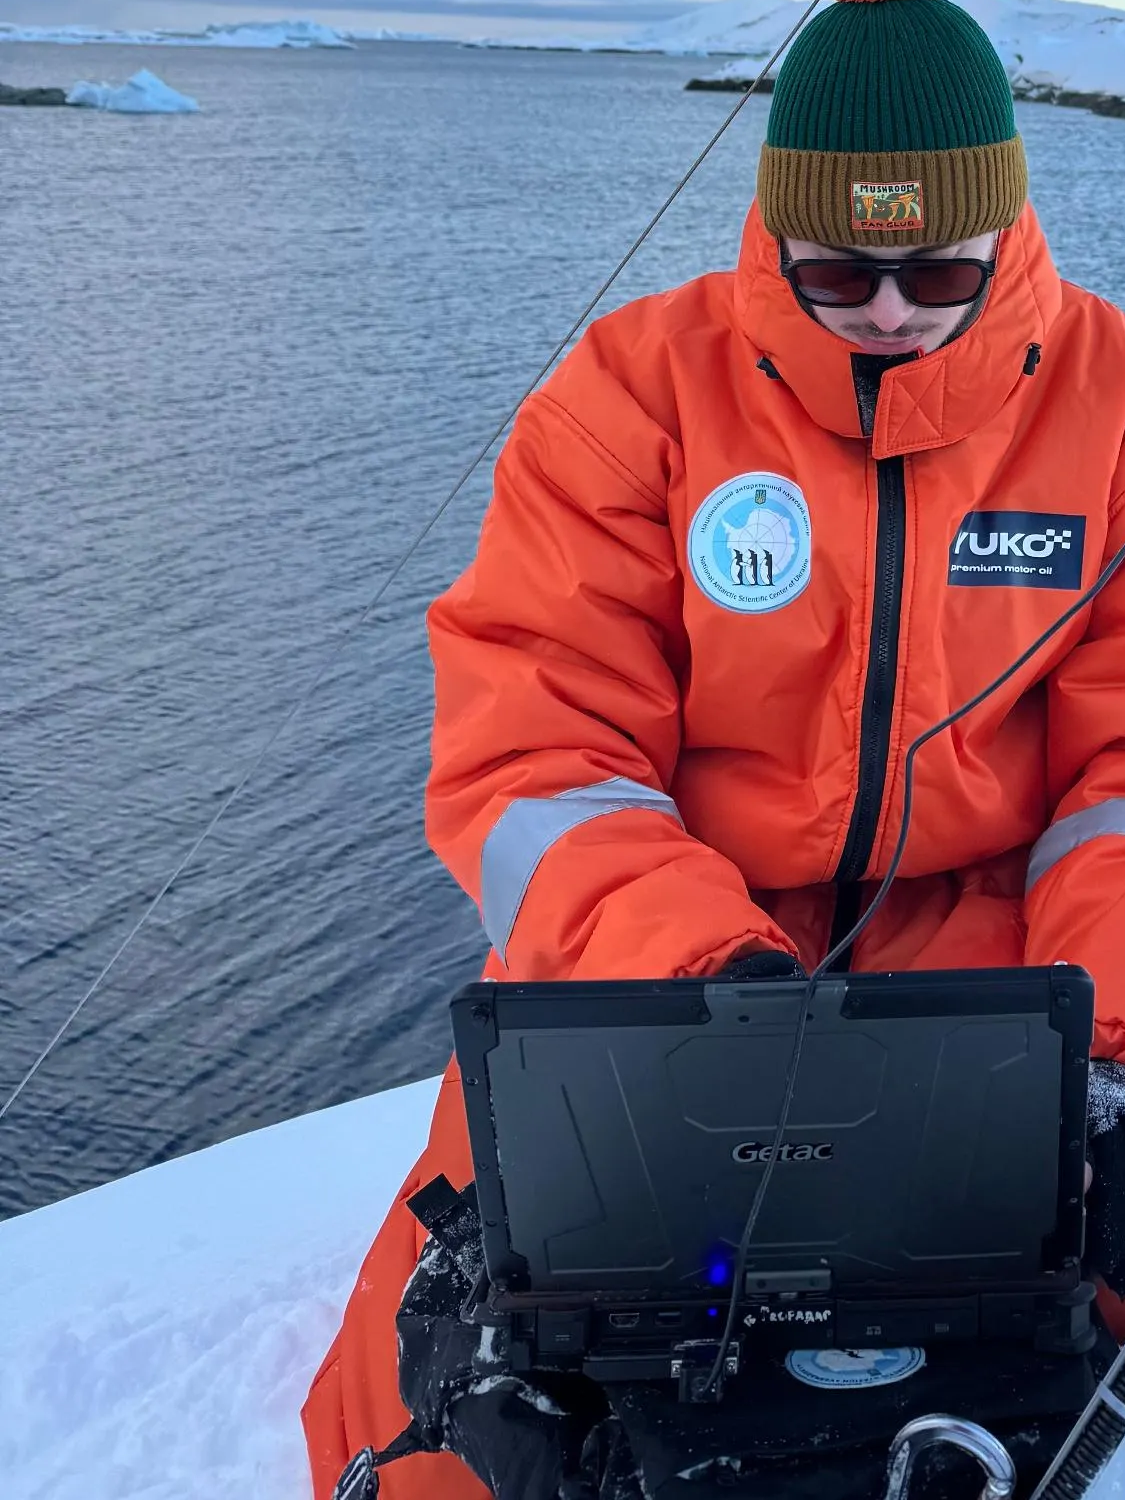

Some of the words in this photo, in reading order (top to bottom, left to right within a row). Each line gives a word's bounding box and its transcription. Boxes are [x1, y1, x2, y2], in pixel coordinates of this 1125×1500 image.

[861, 184, 914, 193] MUSHROOM
[954, 530, 1055, 558] YUKO
[700, 555, 714, 583] National
[713, 581, 737, 600] Antarctic
[738, 595, 768, 603] Scientific
[769, 584, 789, 600] Center
[793, 558, 809, 582] Ukraine
[950, 563, 1003, 573] premium
[1004, 565, 1037, 574] motor
[1038, 566, 1053, 575] oil
[732, 1142, 833, 1163] Getac
